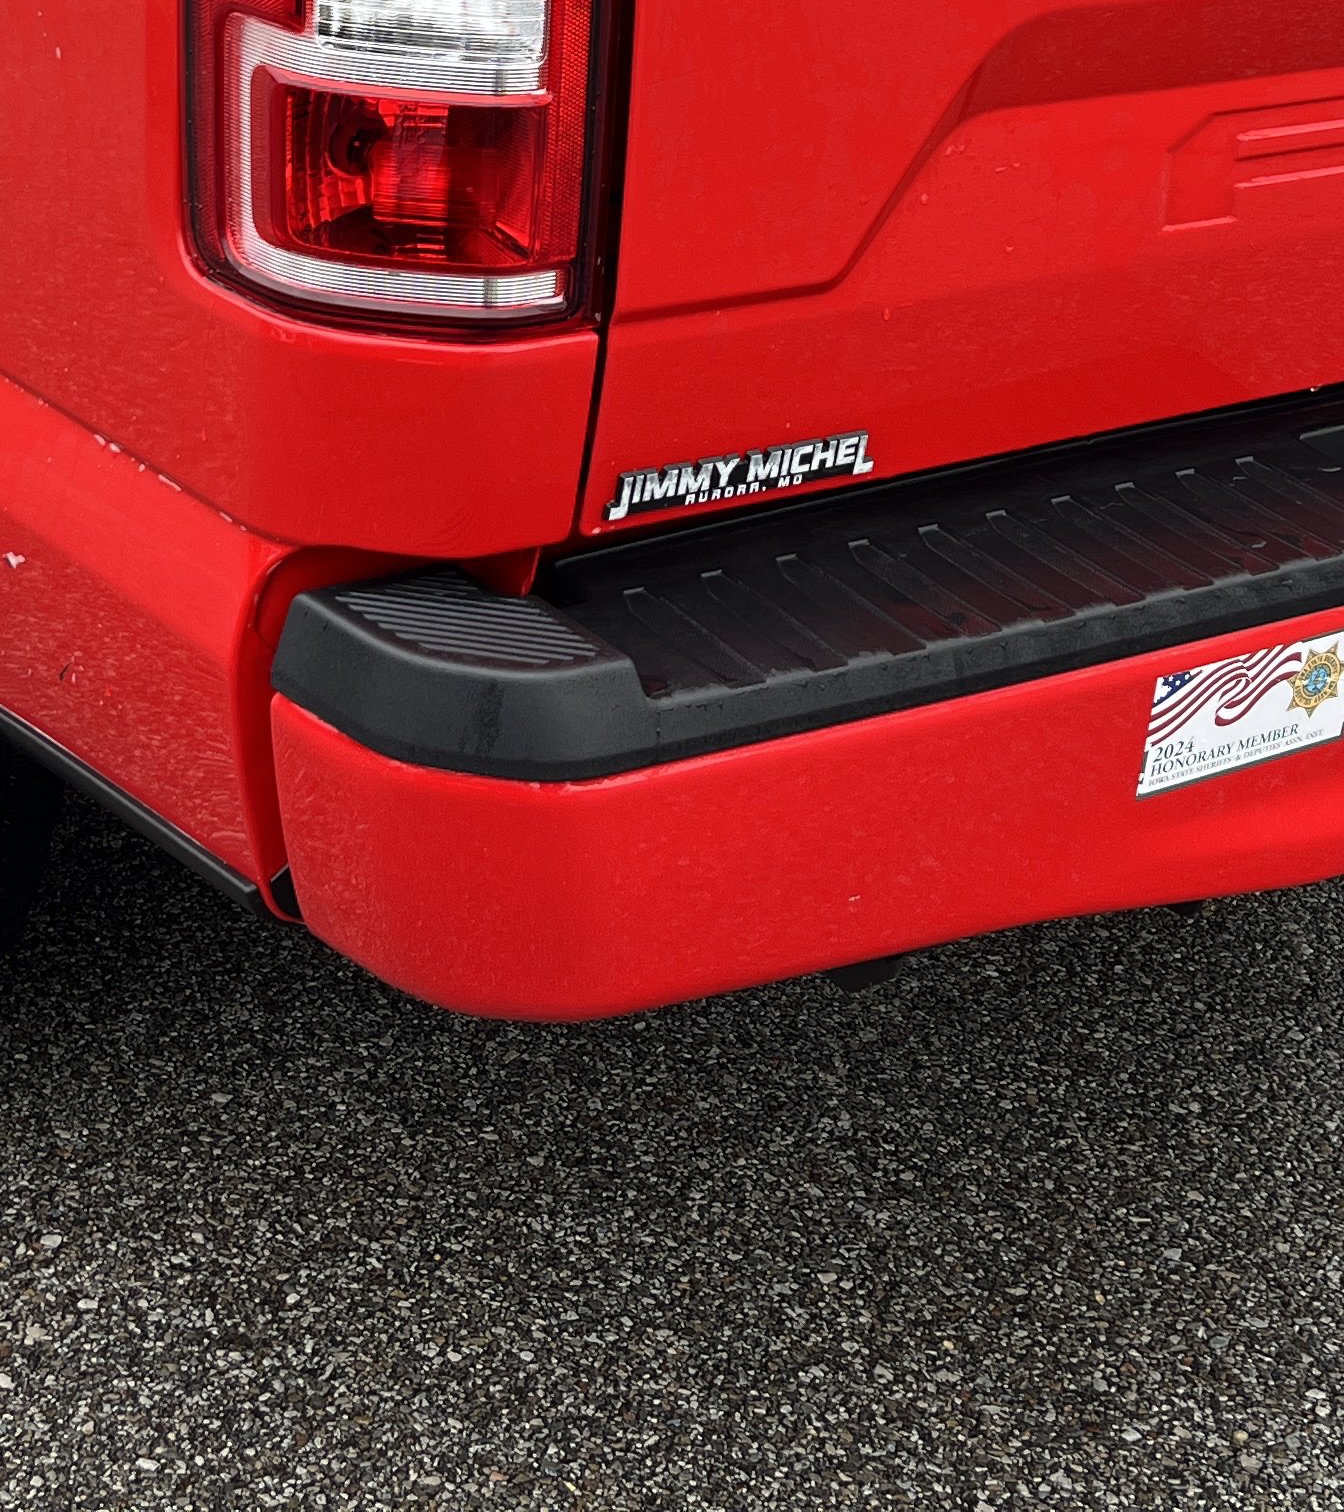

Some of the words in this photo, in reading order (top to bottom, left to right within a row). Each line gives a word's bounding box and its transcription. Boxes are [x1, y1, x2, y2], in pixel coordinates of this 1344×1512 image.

[605, 453, 742, 521] JIMMY
[745, 430, 875, 483] MICHEL
[778, 473, 803, 488] MO
[1150, 741, 1235, 777] HONORARY
[1237, 724, 1299, 752] MEMBER
[1153, 736, 1195, 763] 2024
